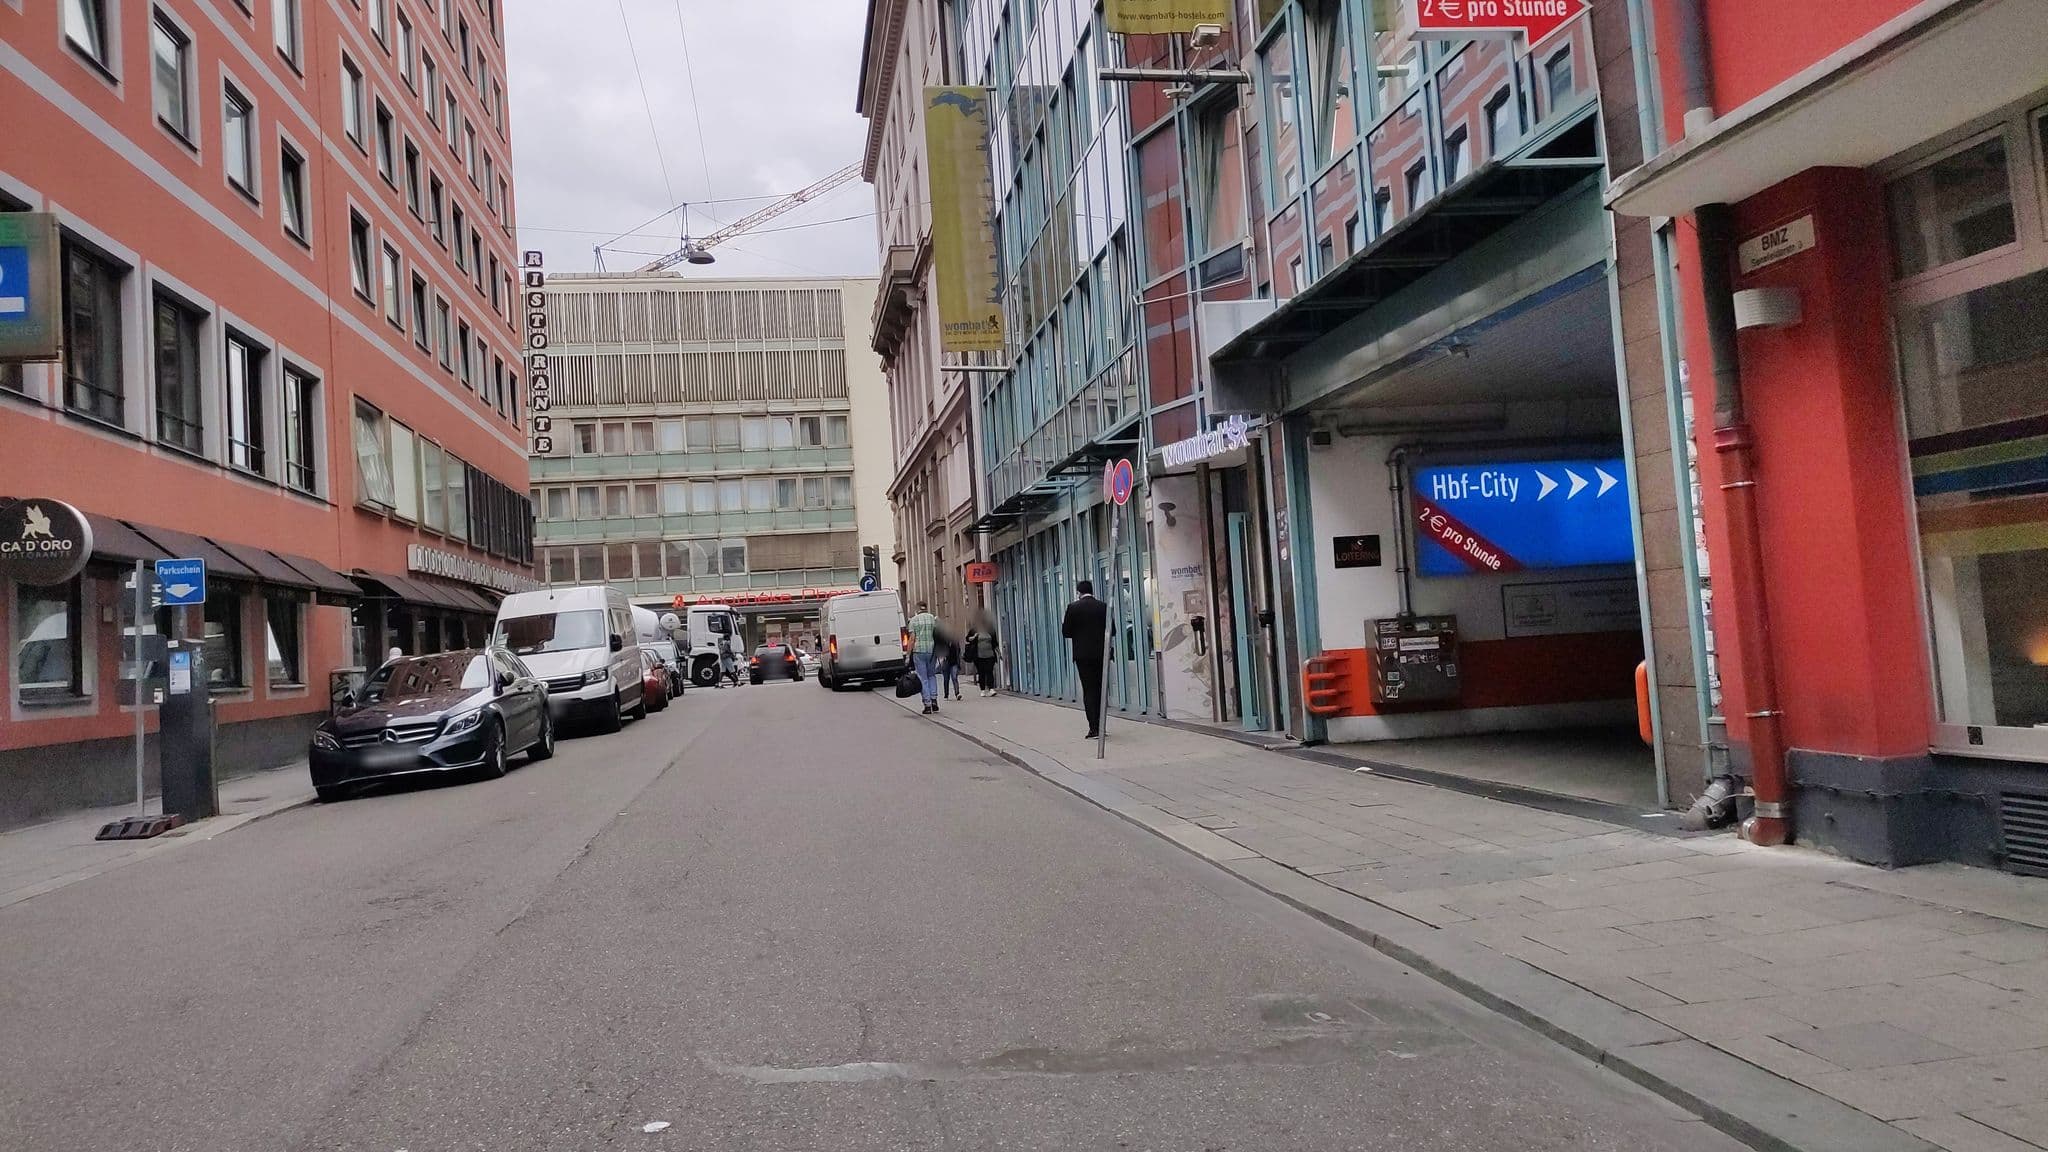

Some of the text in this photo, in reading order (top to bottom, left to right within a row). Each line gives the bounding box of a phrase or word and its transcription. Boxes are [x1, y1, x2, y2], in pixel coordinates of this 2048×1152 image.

[1423, 0, 1567, 22] 2 € pro Stunde
[1761, 227, 1788, 251] BMZ
[526, 252, 551, 453] RISTORANTE
[1432, 471, 1519, 502] Hbf-City
[1420, 507, 1501, 570] 2 € pro Stunde
[159, 566, 201, 575] Parkschein
[973, 564, 992, 577] Ria
